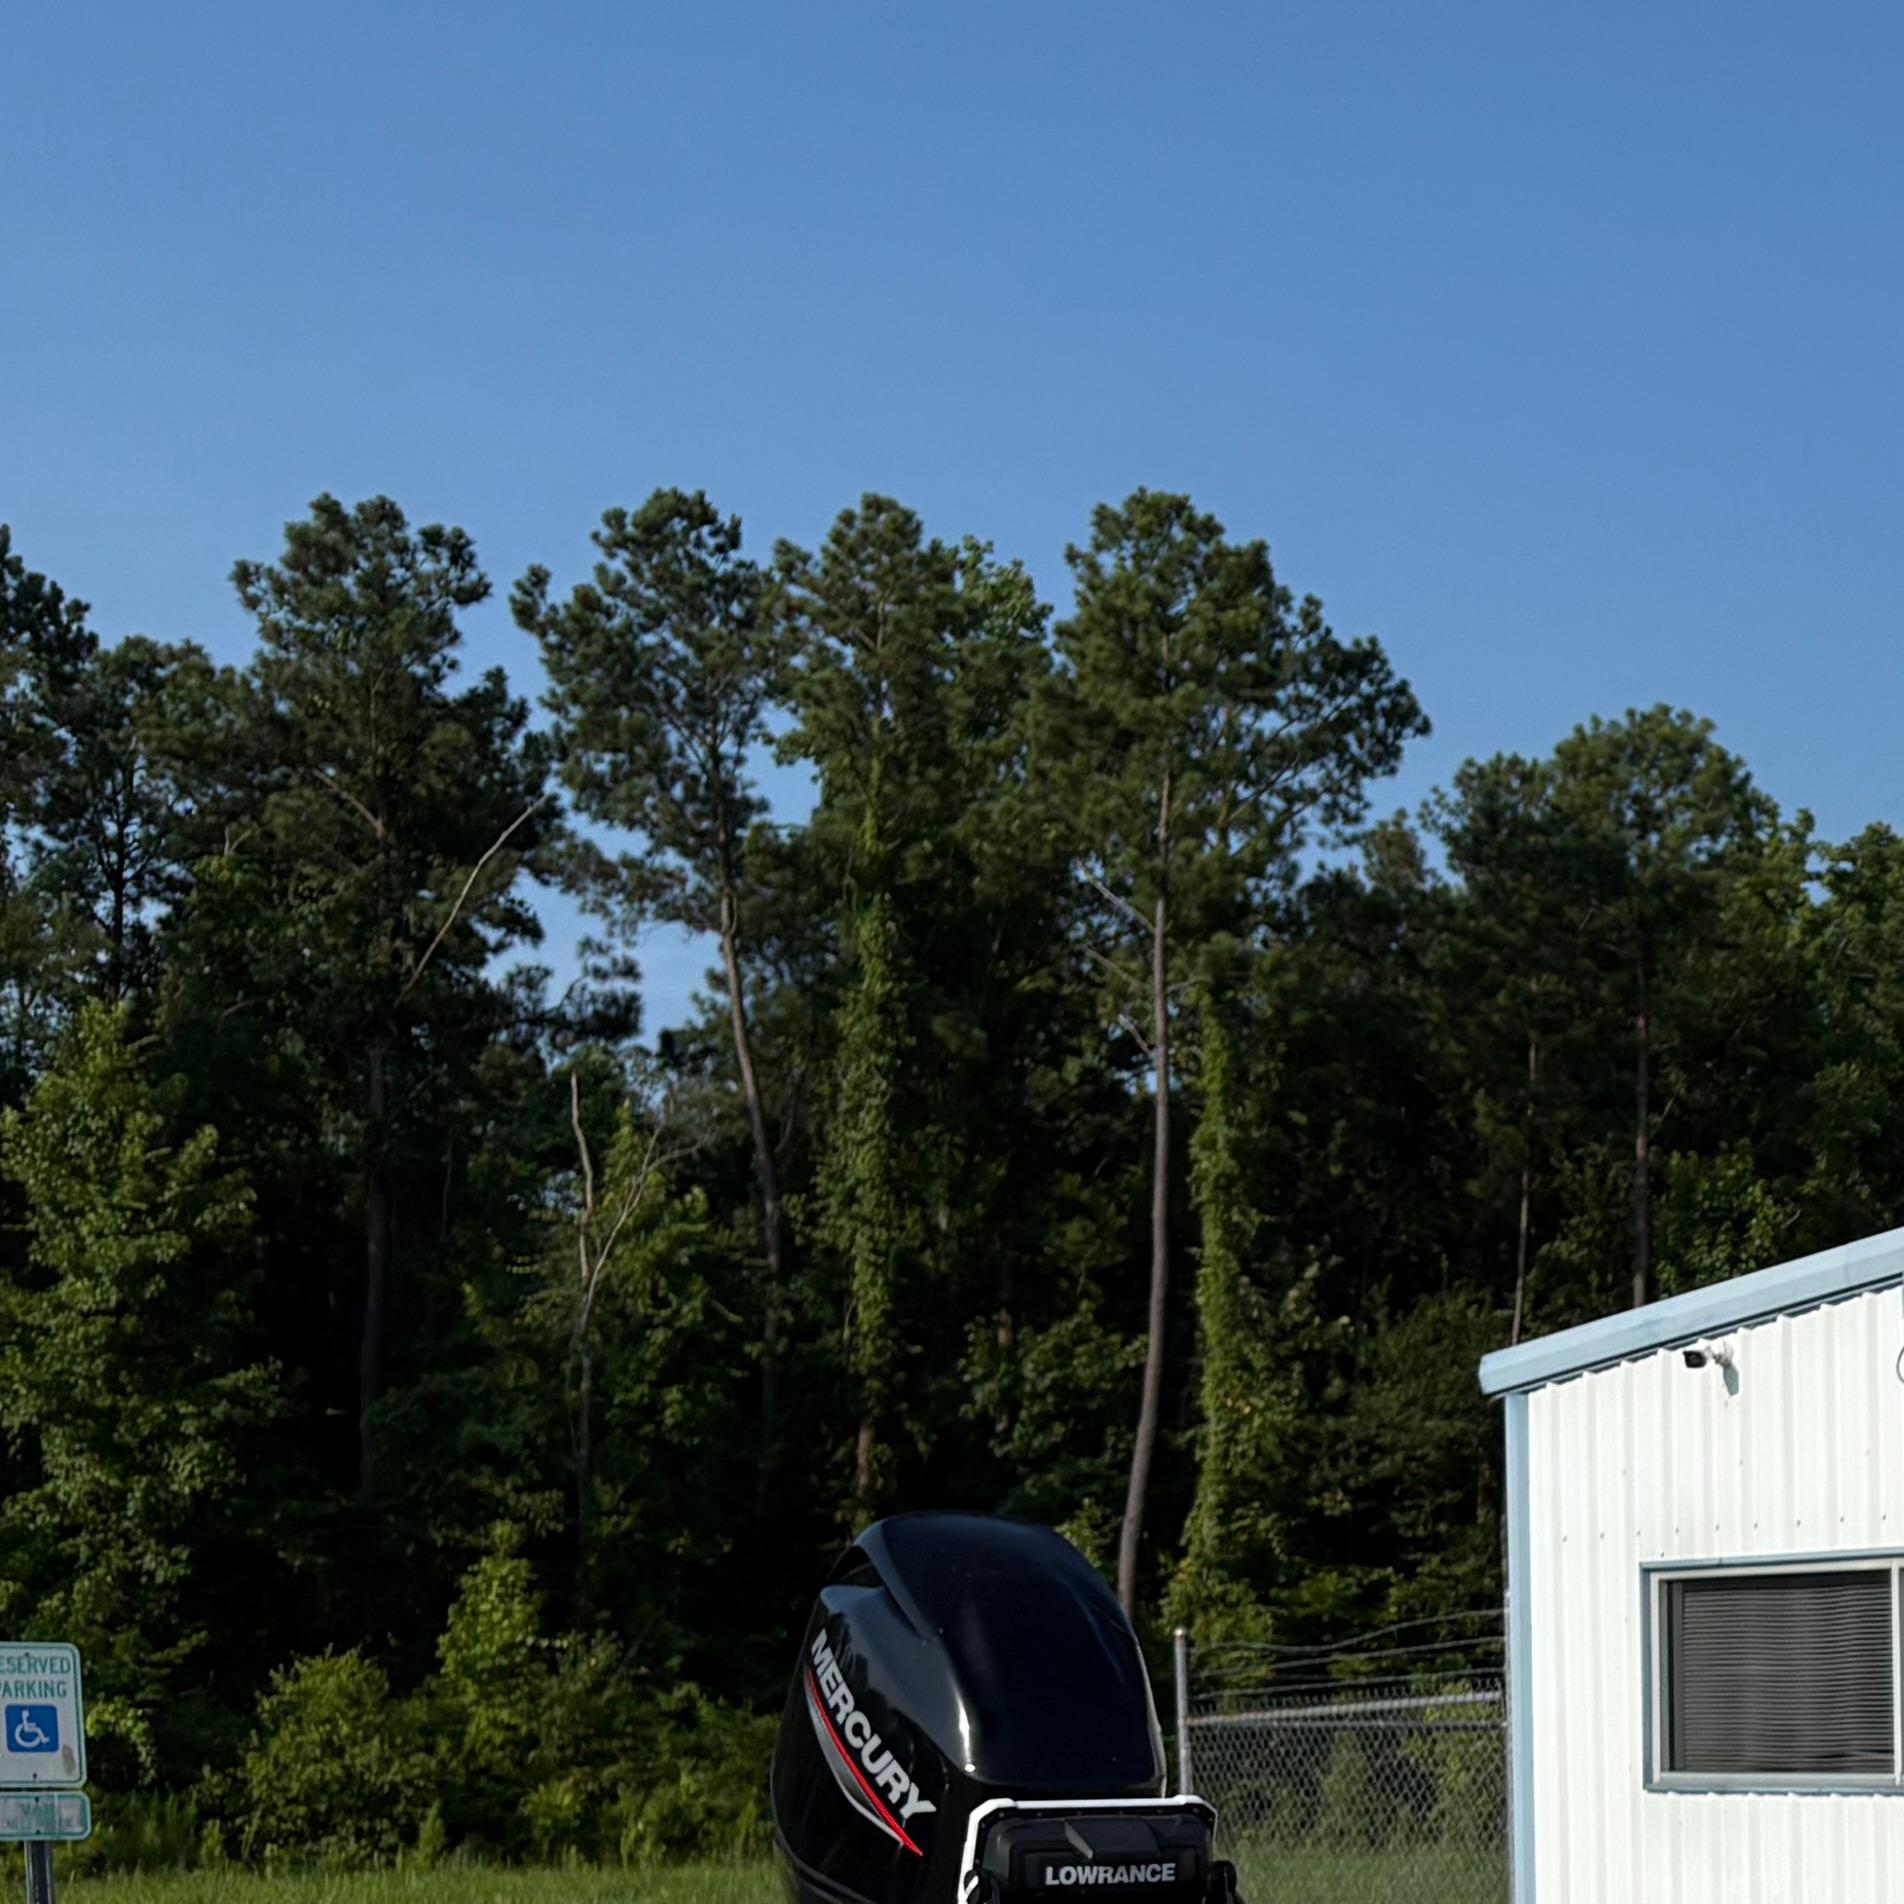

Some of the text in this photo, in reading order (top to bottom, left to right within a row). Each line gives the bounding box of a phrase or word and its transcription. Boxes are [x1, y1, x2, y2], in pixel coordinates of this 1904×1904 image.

[0, 1655, 71, 1675] ESERVED
[810, 1628, 937, 1827] MERCURY
[1044, 1862, 1176, 1887] LOWRANCE
